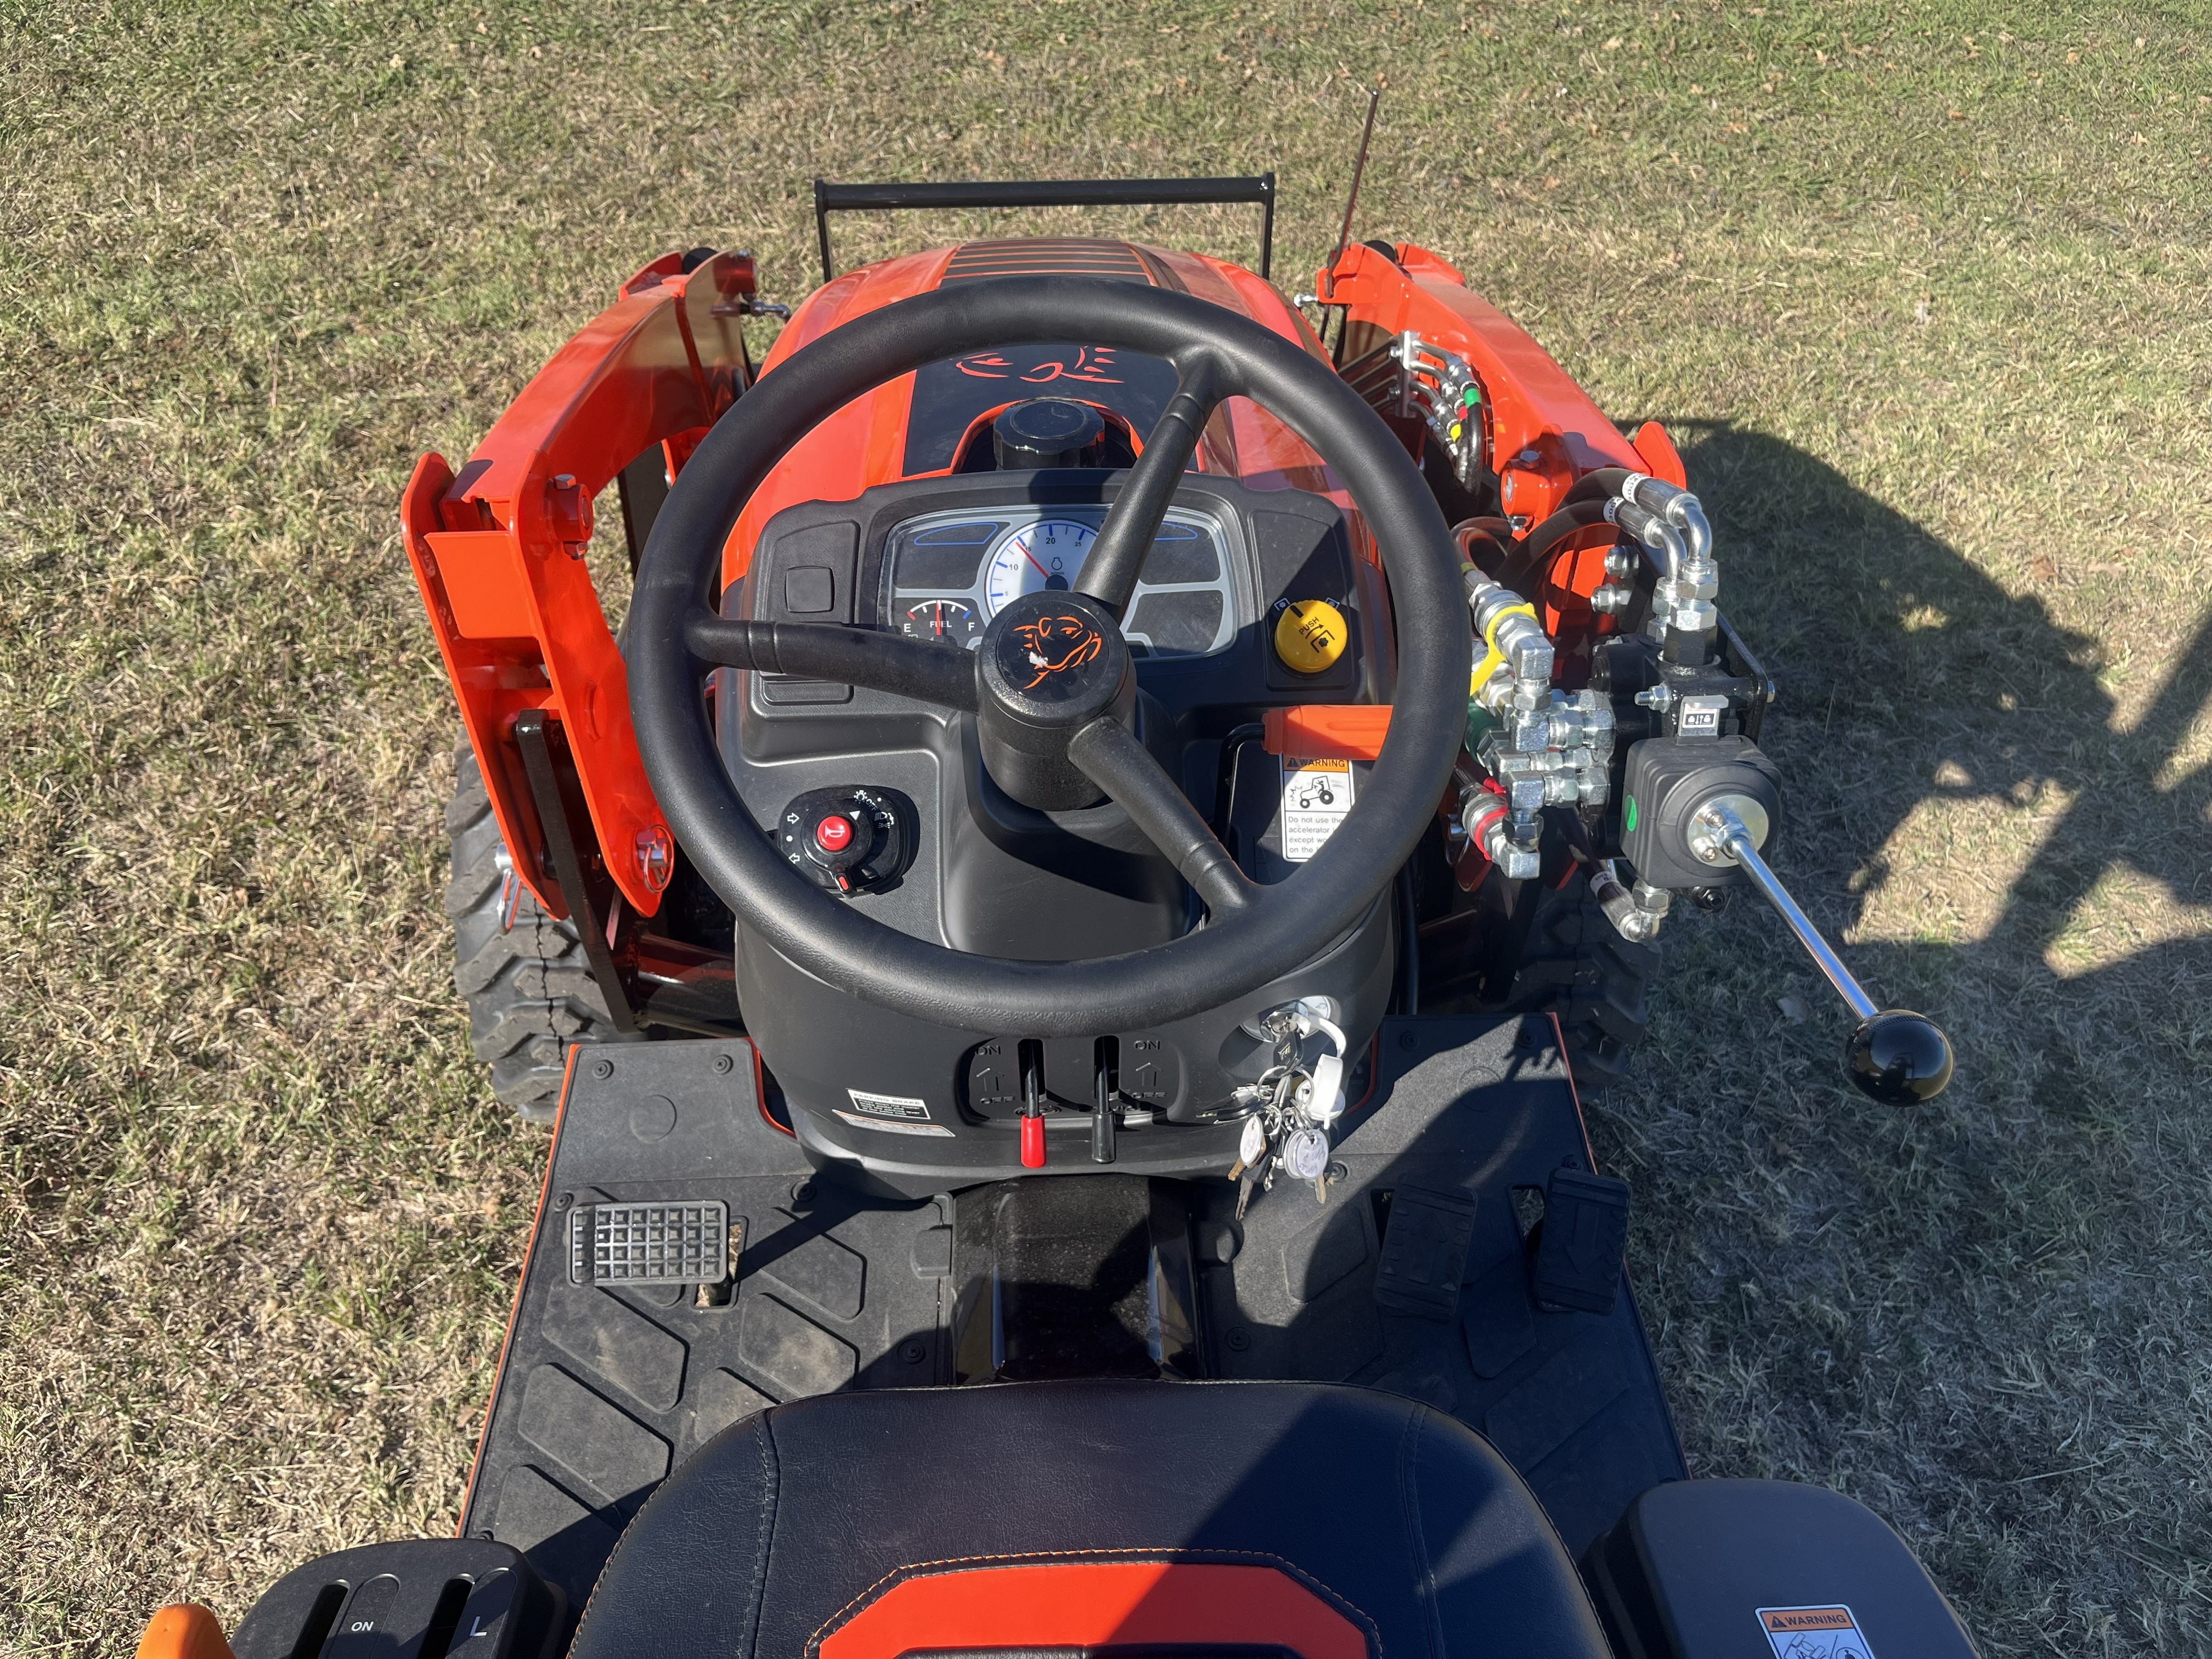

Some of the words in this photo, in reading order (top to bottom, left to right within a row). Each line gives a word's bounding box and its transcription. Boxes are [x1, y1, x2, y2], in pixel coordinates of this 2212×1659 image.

[904, 623, 911, 633] E
[968, 622, 975, 631] F
[1299, 616, 1320, 635] PUSH
[1300, 759, 1345, 767] WARNING
[866, 799, 878, 811] OFF
[1133, 1040, 1161, 1050] ON
[975, 1045, 1001, 1056] ON
[854, 1092, 889, 1102] PARKING
[980, 1096, 1016, 1104] OFF
[1784, 1614, 1847, 1626] WARNING
[351, 1621, 374, 1633] ON
[470, 1616, 488, 1637] L
